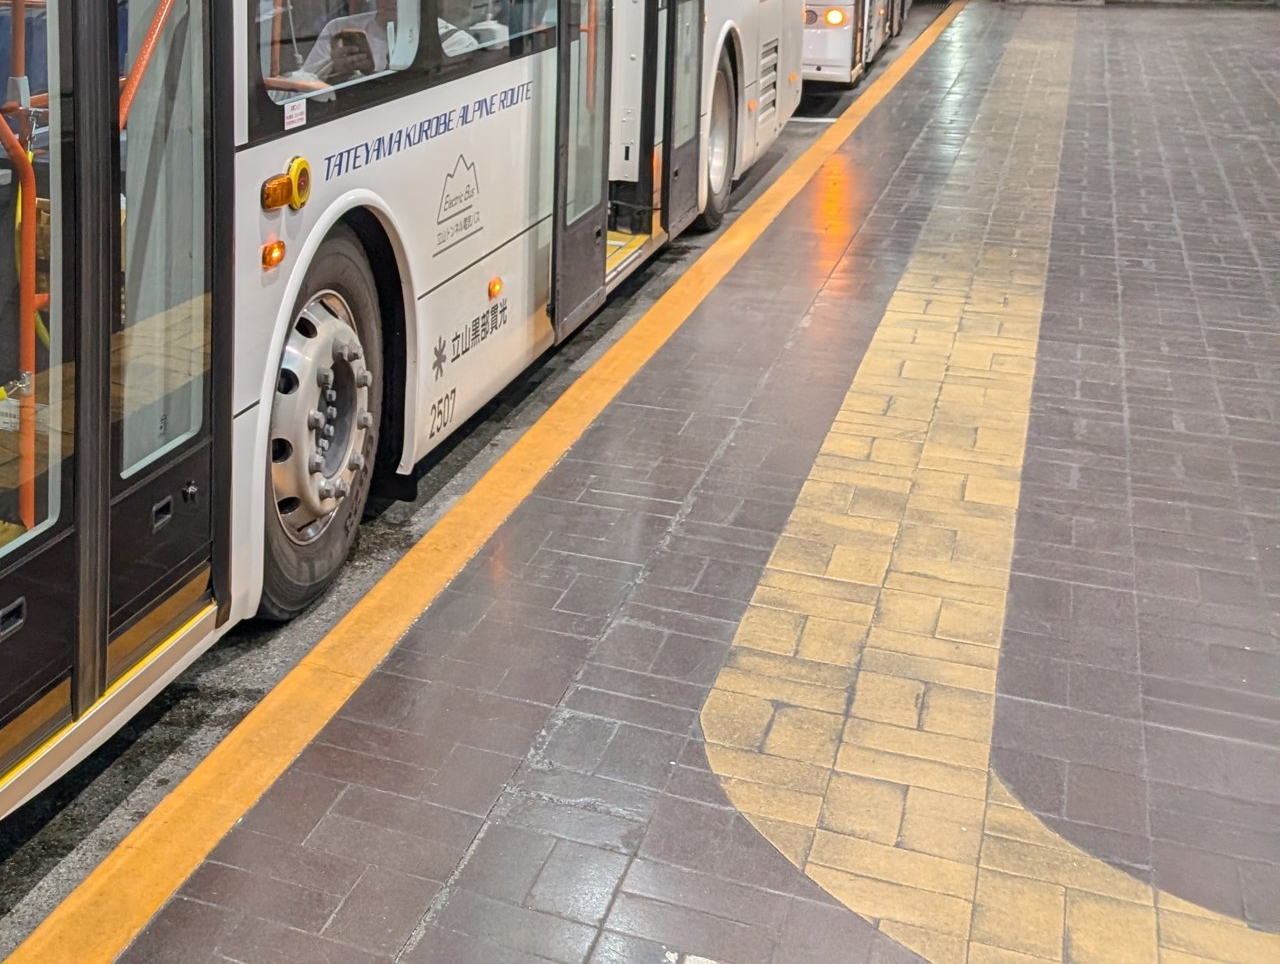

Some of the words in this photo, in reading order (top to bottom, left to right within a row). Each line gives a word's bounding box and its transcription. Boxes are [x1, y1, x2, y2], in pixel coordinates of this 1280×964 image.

[323, 128, 404, 182] TATEYAMA
[403, 109, 457, 150] KUROBE
[455, 93, 499, 129] ALPINE
[498, 81, 534, 111] ROUTE
[450, 297, 508, 363] 立山黒部貫光
[428, 387, 457, 440] 2507
